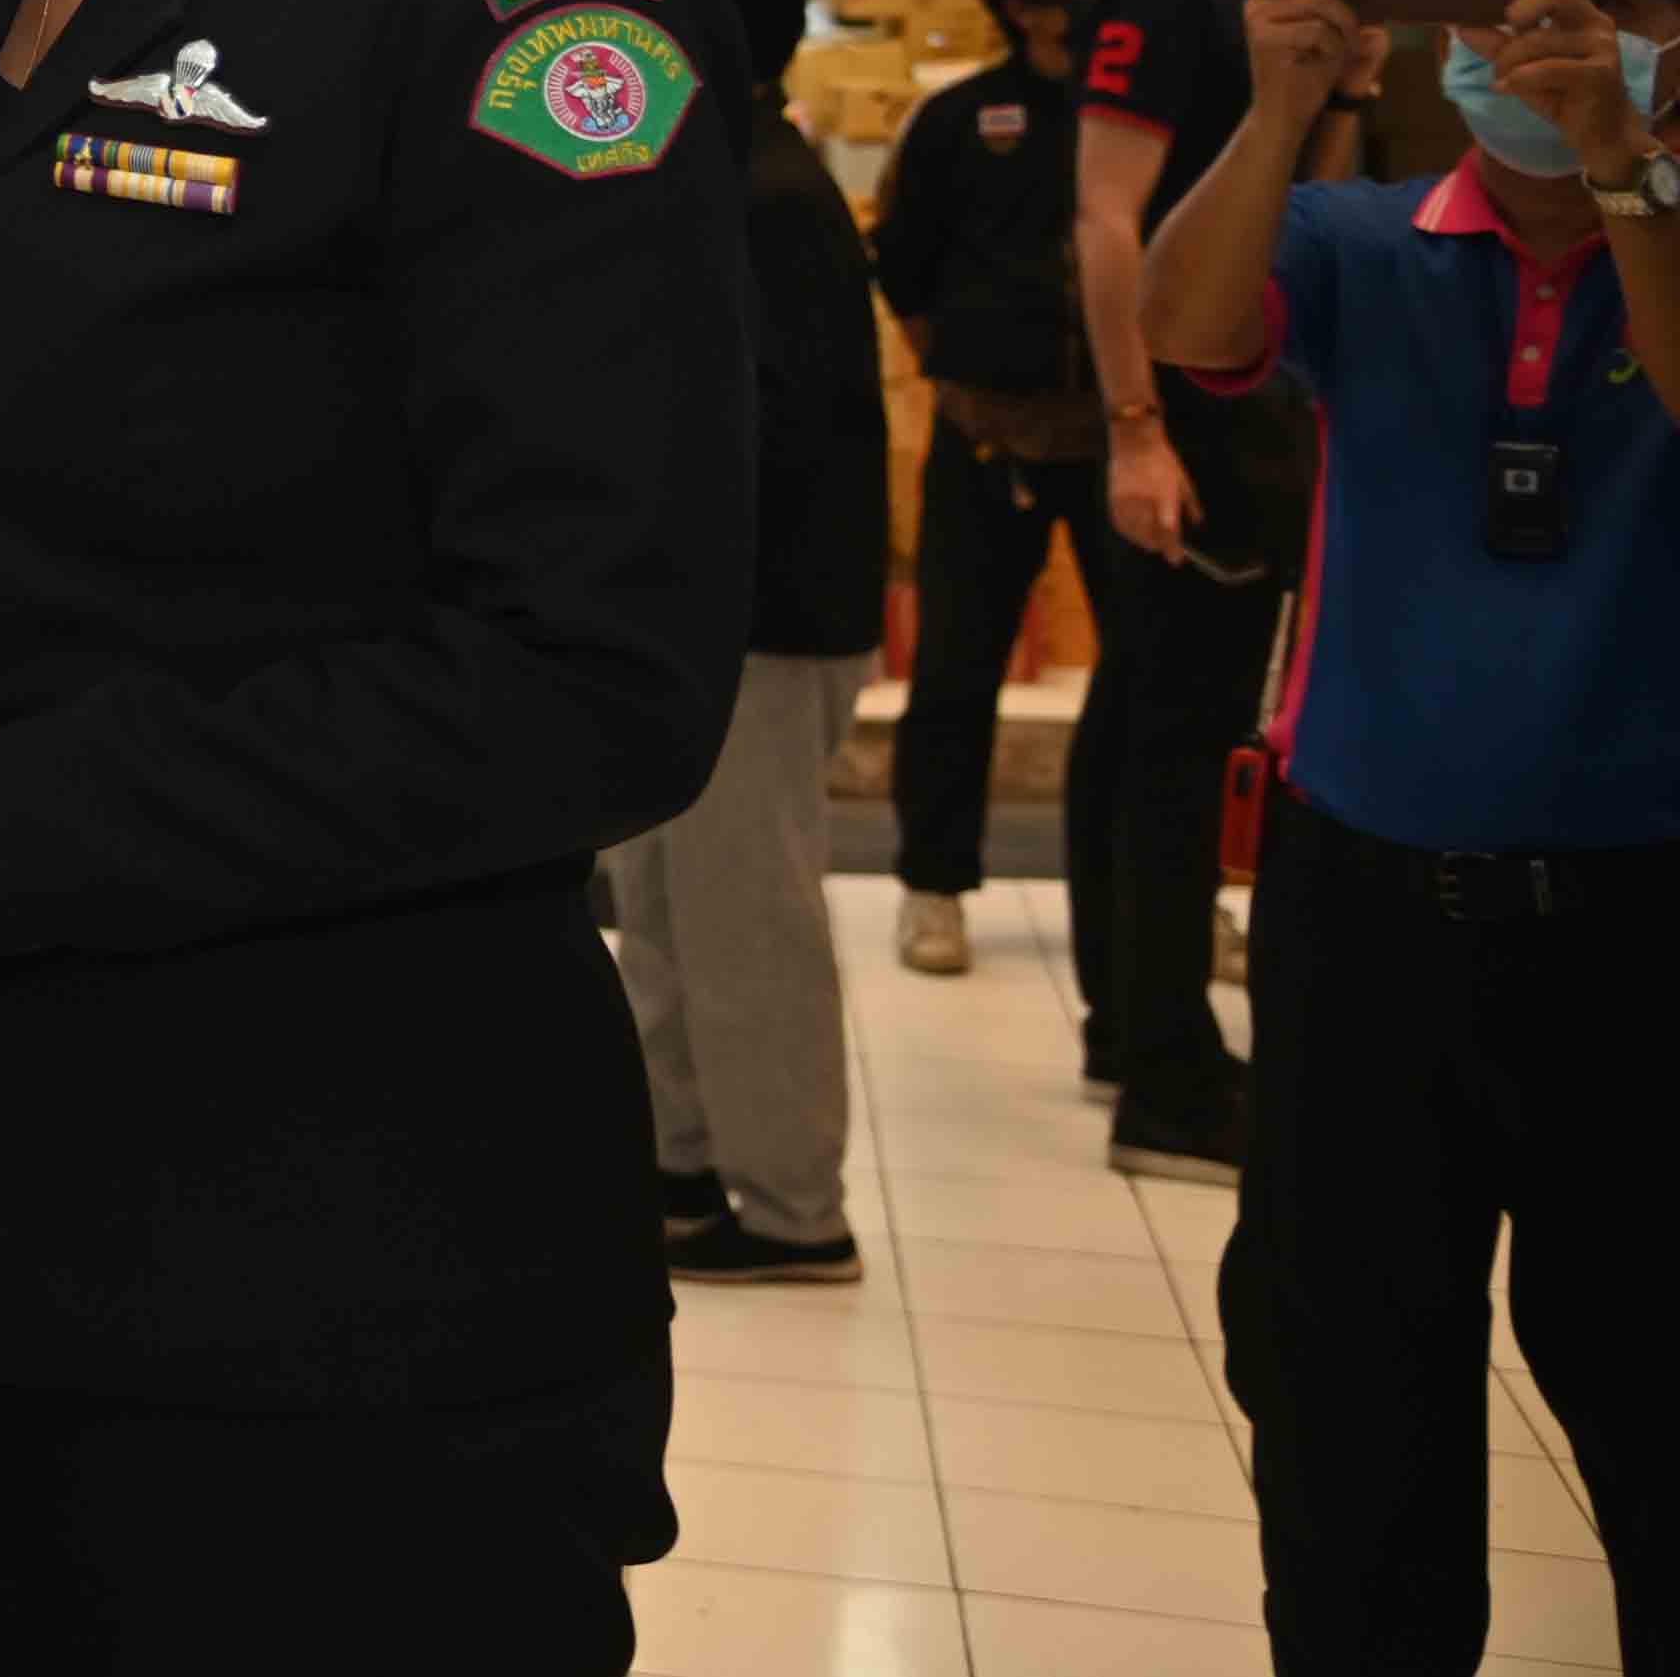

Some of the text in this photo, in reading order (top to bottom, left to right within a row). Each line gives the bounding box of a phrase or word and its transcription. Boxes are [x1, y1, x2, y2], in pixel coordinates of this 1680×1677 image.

[488, 15, 684, 109] กรุงเทพมหานคร
[1086, 20, 1144, 95] 2
